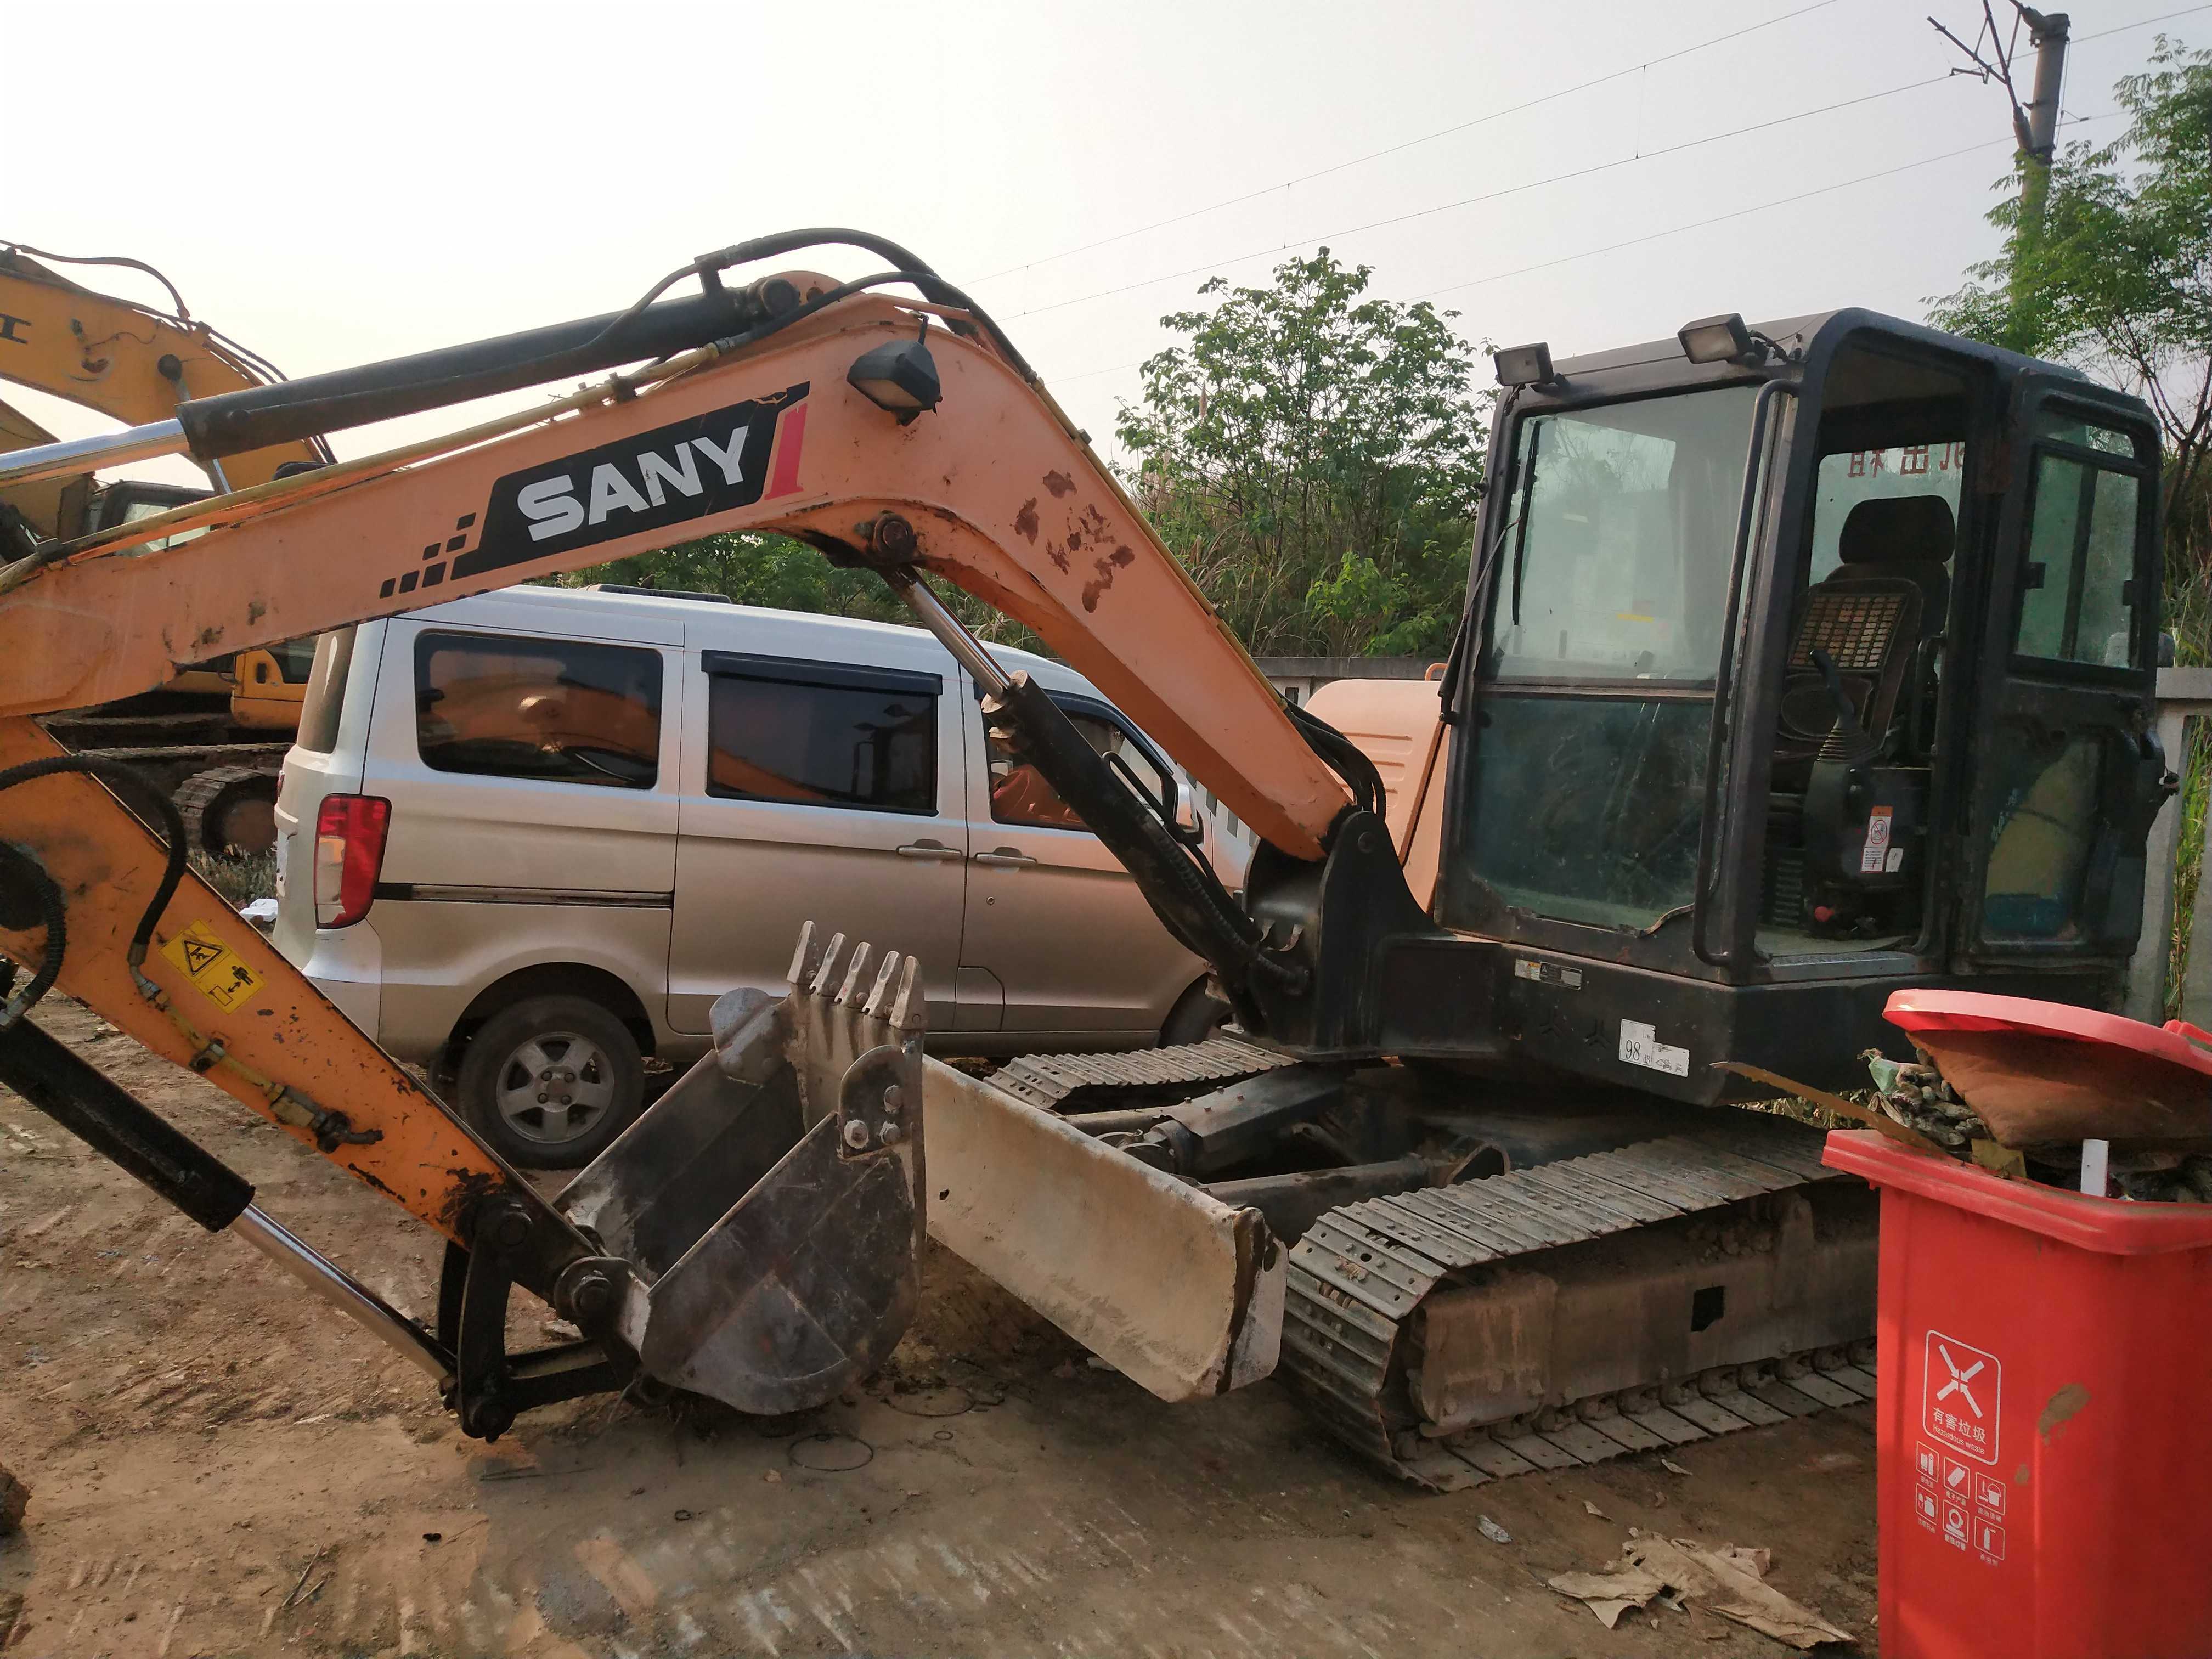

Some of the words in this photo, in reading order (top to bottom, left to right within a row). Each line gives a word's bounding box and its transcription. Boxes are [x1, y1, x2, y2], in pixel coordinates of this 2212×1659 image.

[517, 426, 749, 541] SANY
[1626, 1040, 1640, 1061] 98
[1933, 1407, 1987, 1444] 有害垃圾
